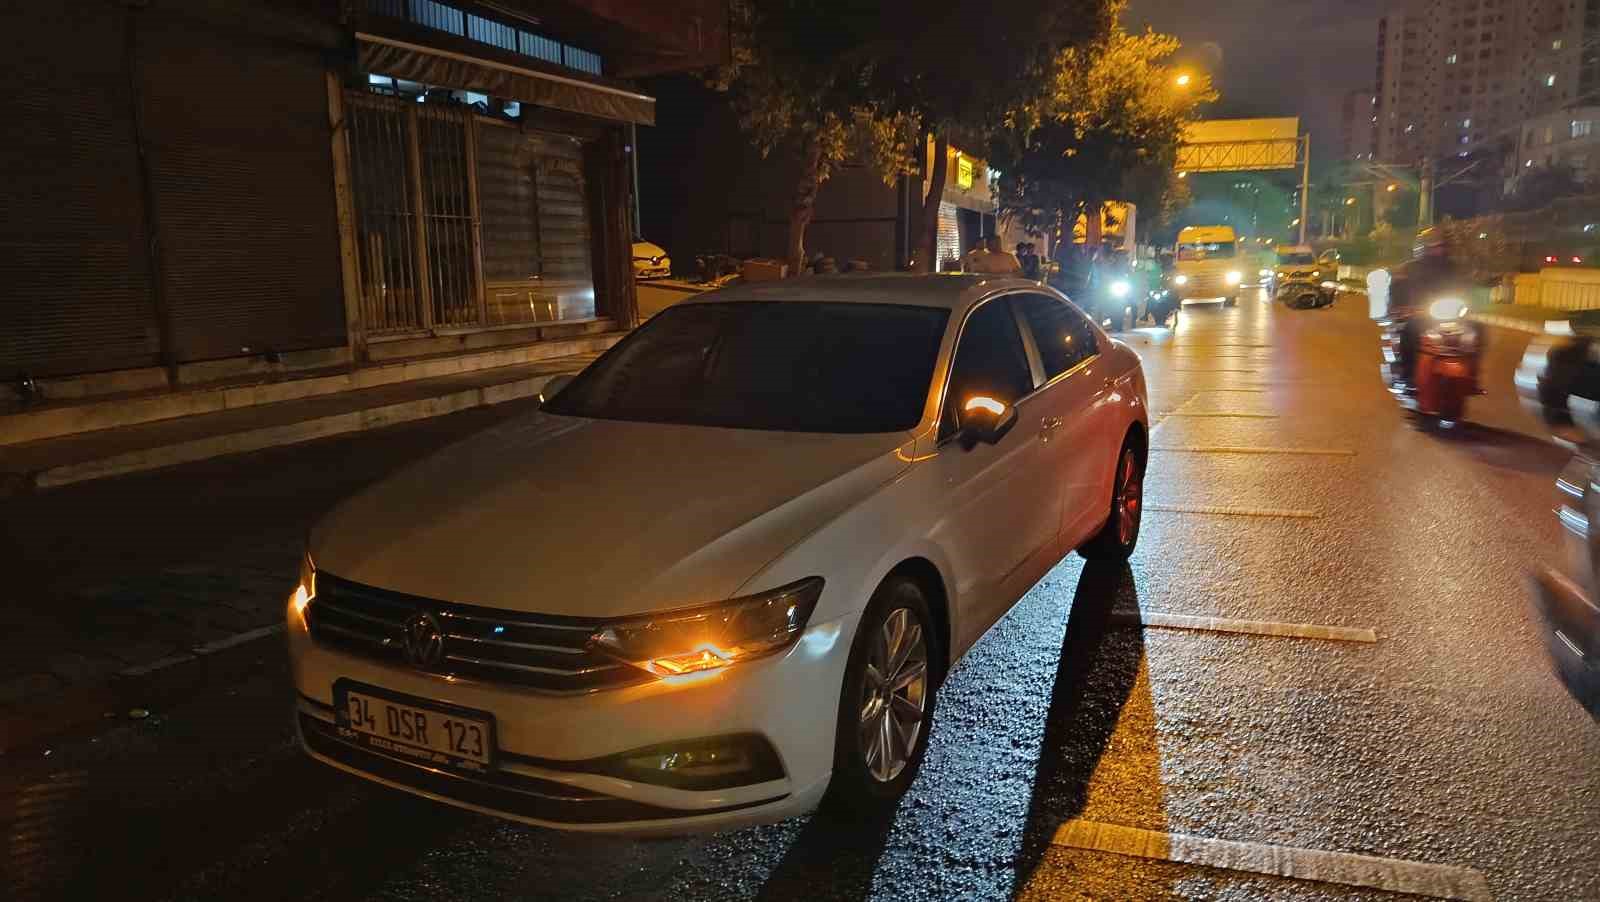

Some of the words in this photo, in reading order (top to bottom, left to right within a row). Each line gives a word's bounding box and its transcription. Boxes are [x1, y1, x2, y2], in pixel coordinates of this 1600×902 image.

[349, 696, 376, 731] 34
[386, 705, 428, 745] DSR
[443, 719, 483, 757] 123
